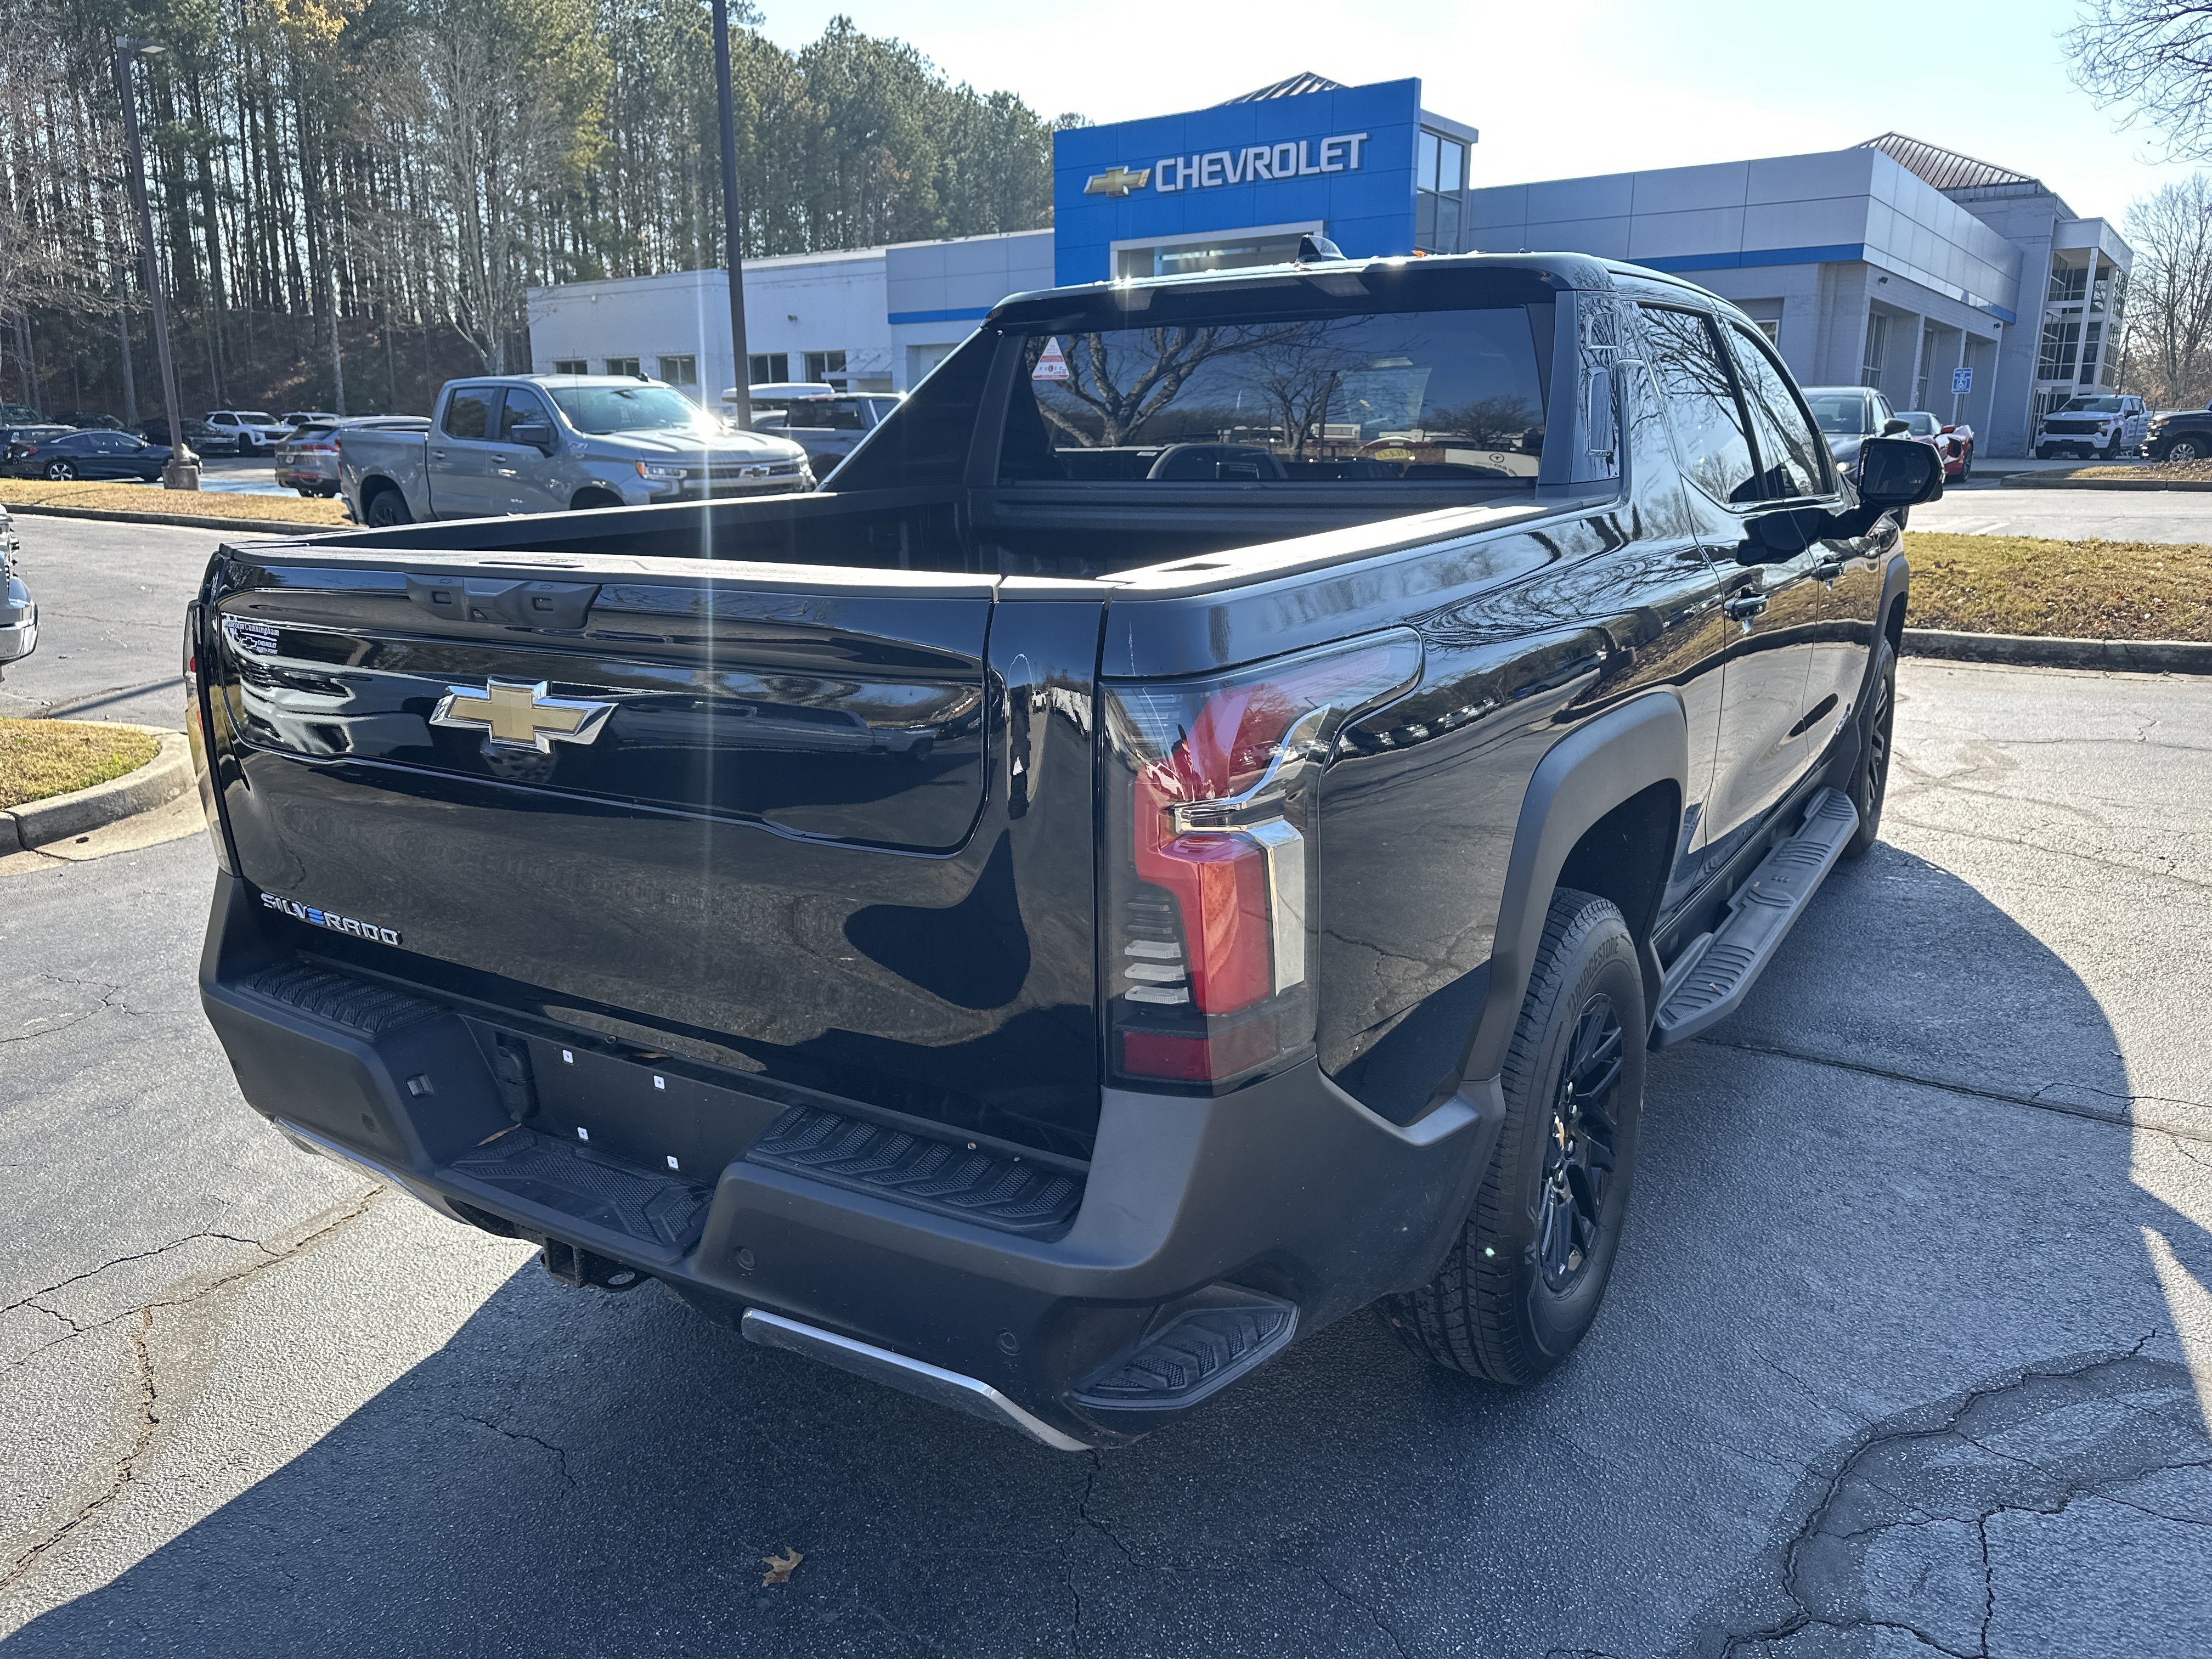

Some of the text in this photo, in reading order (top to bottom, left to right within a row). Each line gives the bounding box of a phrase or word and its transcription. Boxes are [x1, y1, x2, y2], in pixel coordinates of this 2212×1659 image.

[1155, 133, 1369, 193] CHEVROLET
[245, 623, 279, 636] Cunningham
[261, 892, 402, 946] SILVERADO
[1566, 935, 1619, 1022] BRIDGESTONE
